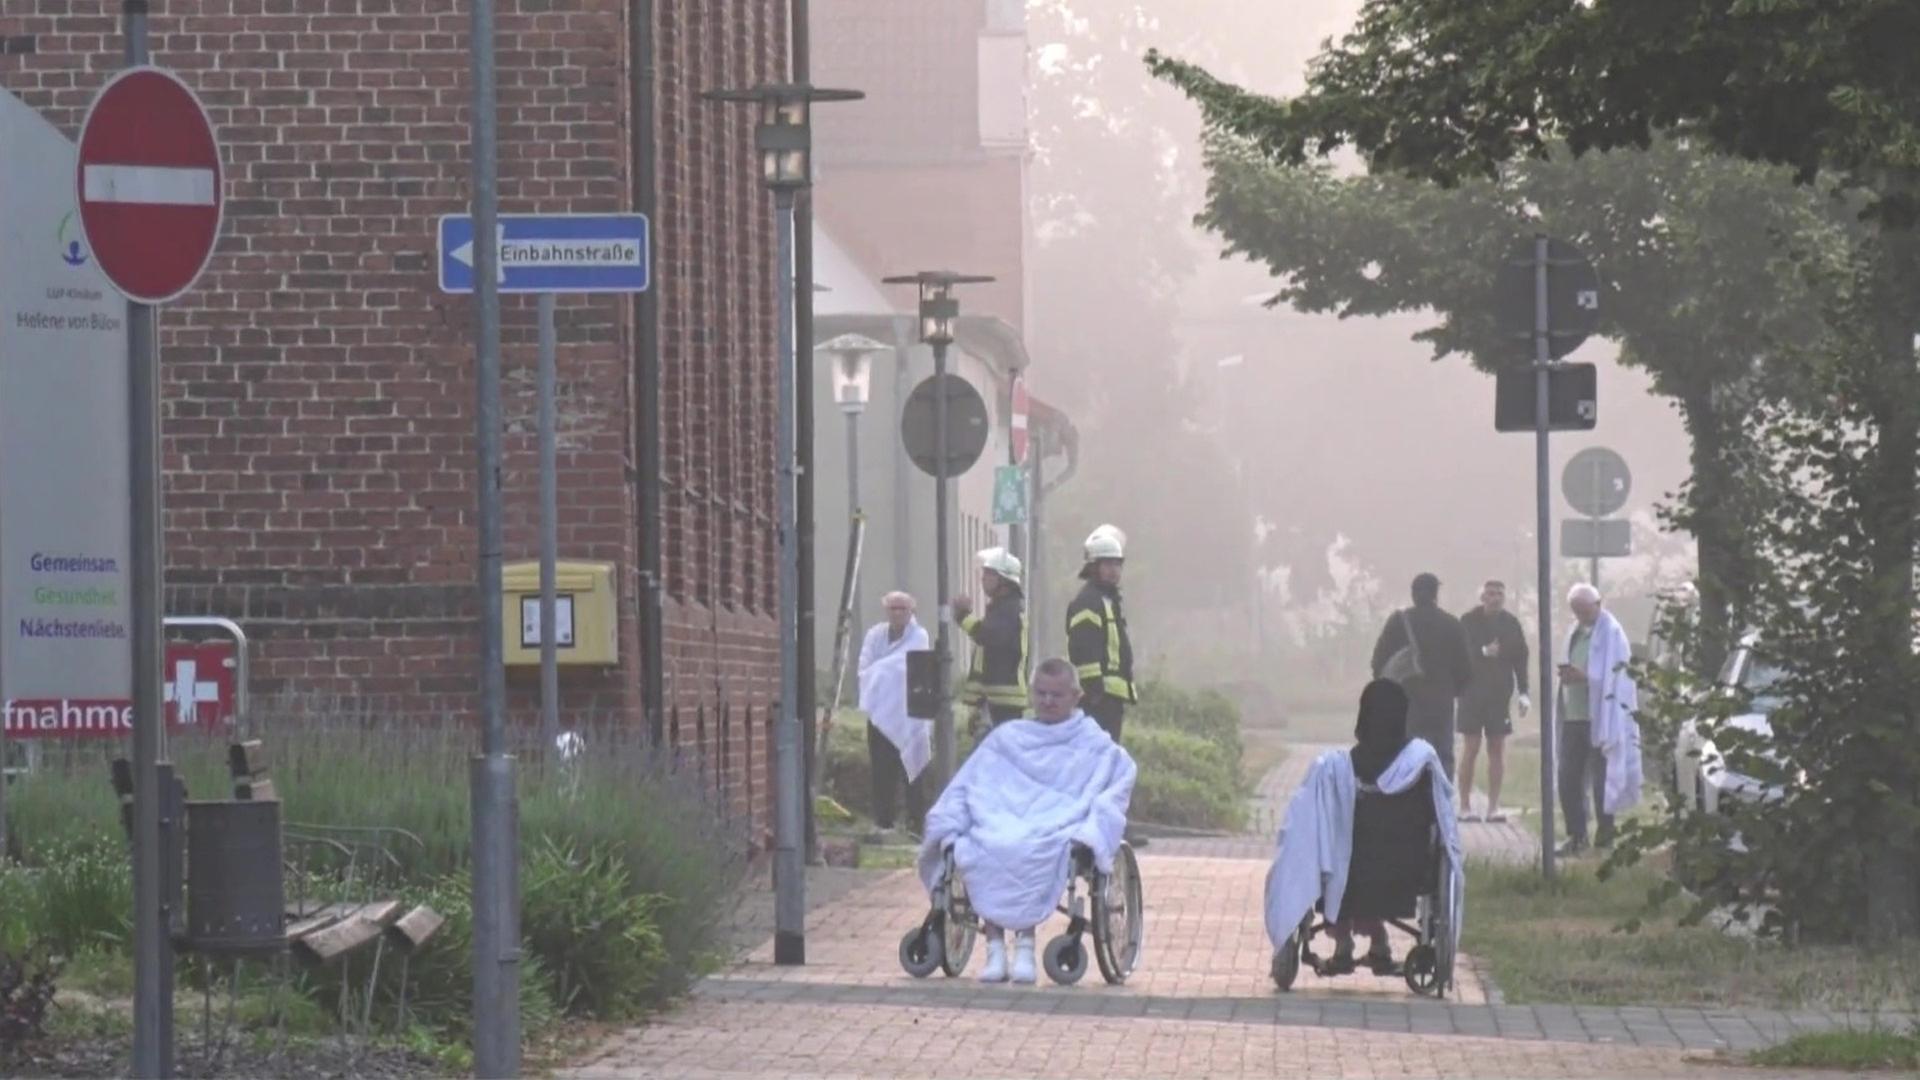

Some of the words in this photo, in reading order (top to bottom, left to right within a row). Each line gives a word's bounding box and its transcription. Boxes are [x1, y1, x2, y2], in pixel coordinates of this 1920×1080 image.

[501, 244, 634, 262] Einbahnstraße
[17, 311, 64, 329] Helene
[67, 316, 89, 330] von
